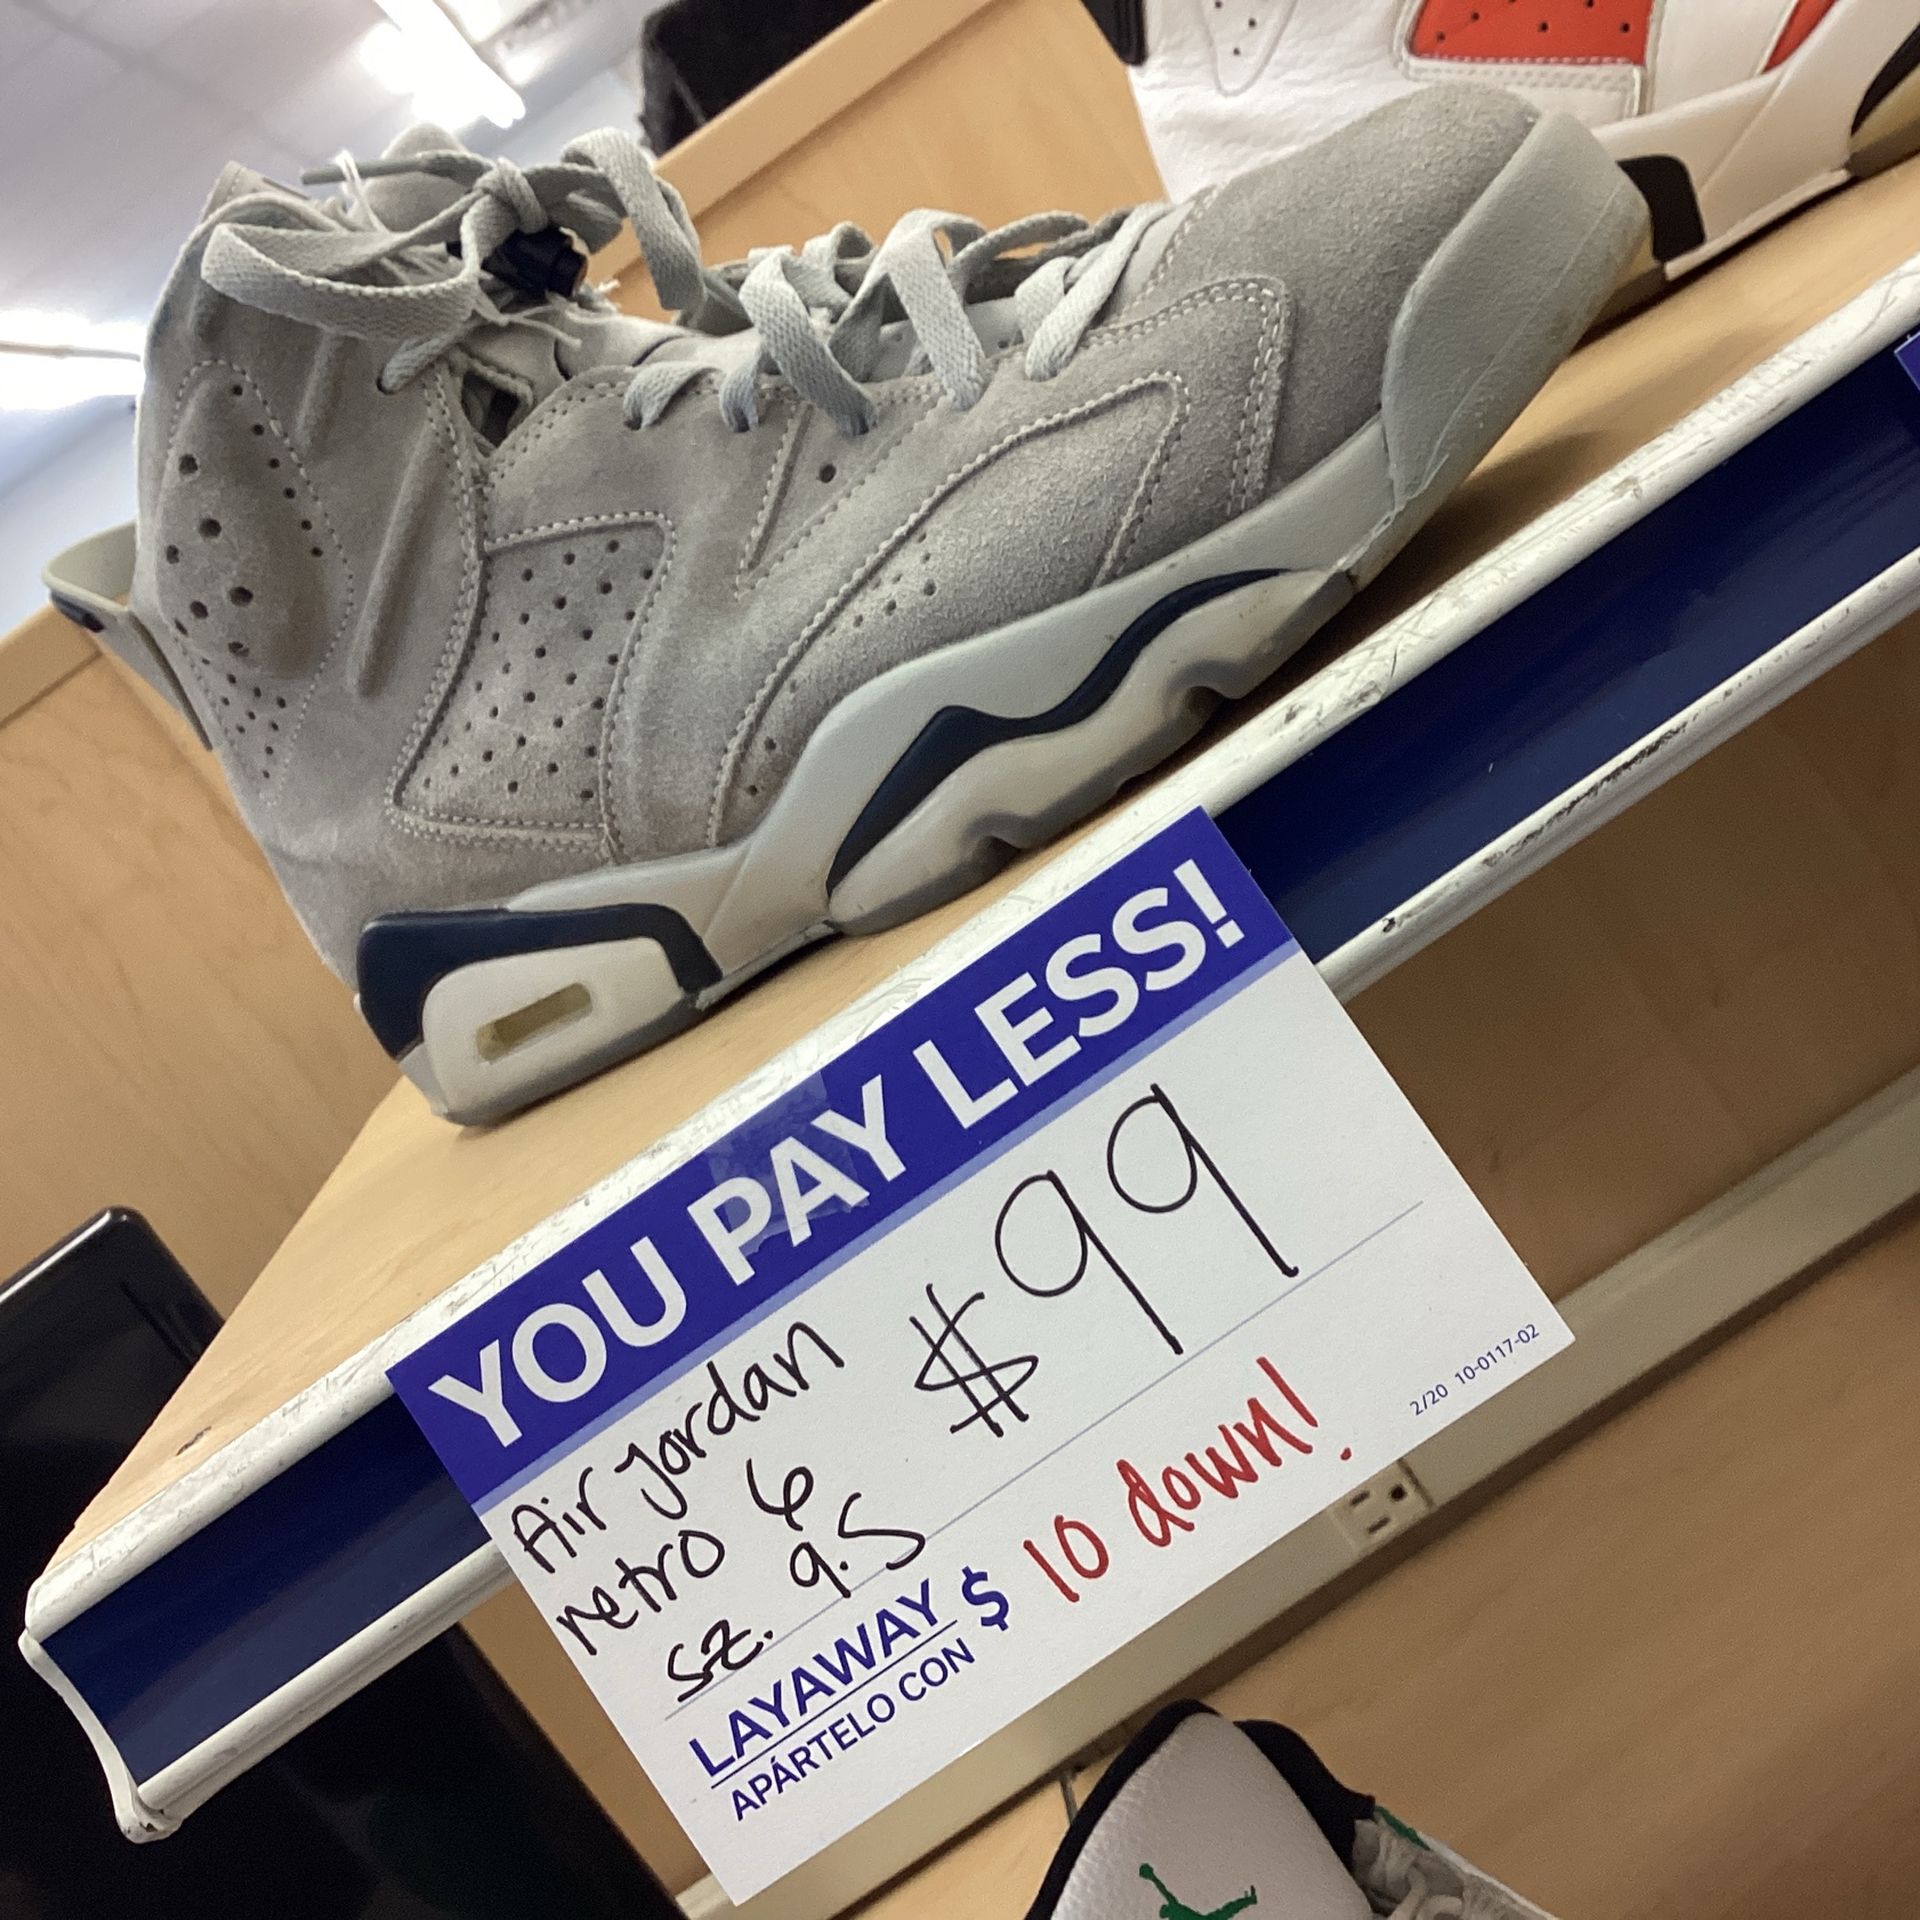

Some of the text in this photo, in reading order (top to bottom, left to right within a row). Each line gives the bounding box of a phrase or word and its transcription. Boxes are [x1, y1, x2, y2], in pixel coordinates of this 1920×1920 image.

[428, 859, 1245, 1448] YOU PAY LESS!
[510, 1321, 845, 1573] Air Jordan
[1410, 1322, 1540, 1417] 2/20 10-0117-02
[746, 1458, 815, 1531] 6
[1023, 1356, 1352, 1602] 10 down!
[688, 1565, 1010, 1777] LAYAWAY $
[730, 1637, 976, 1821] APÁRTELO CON
